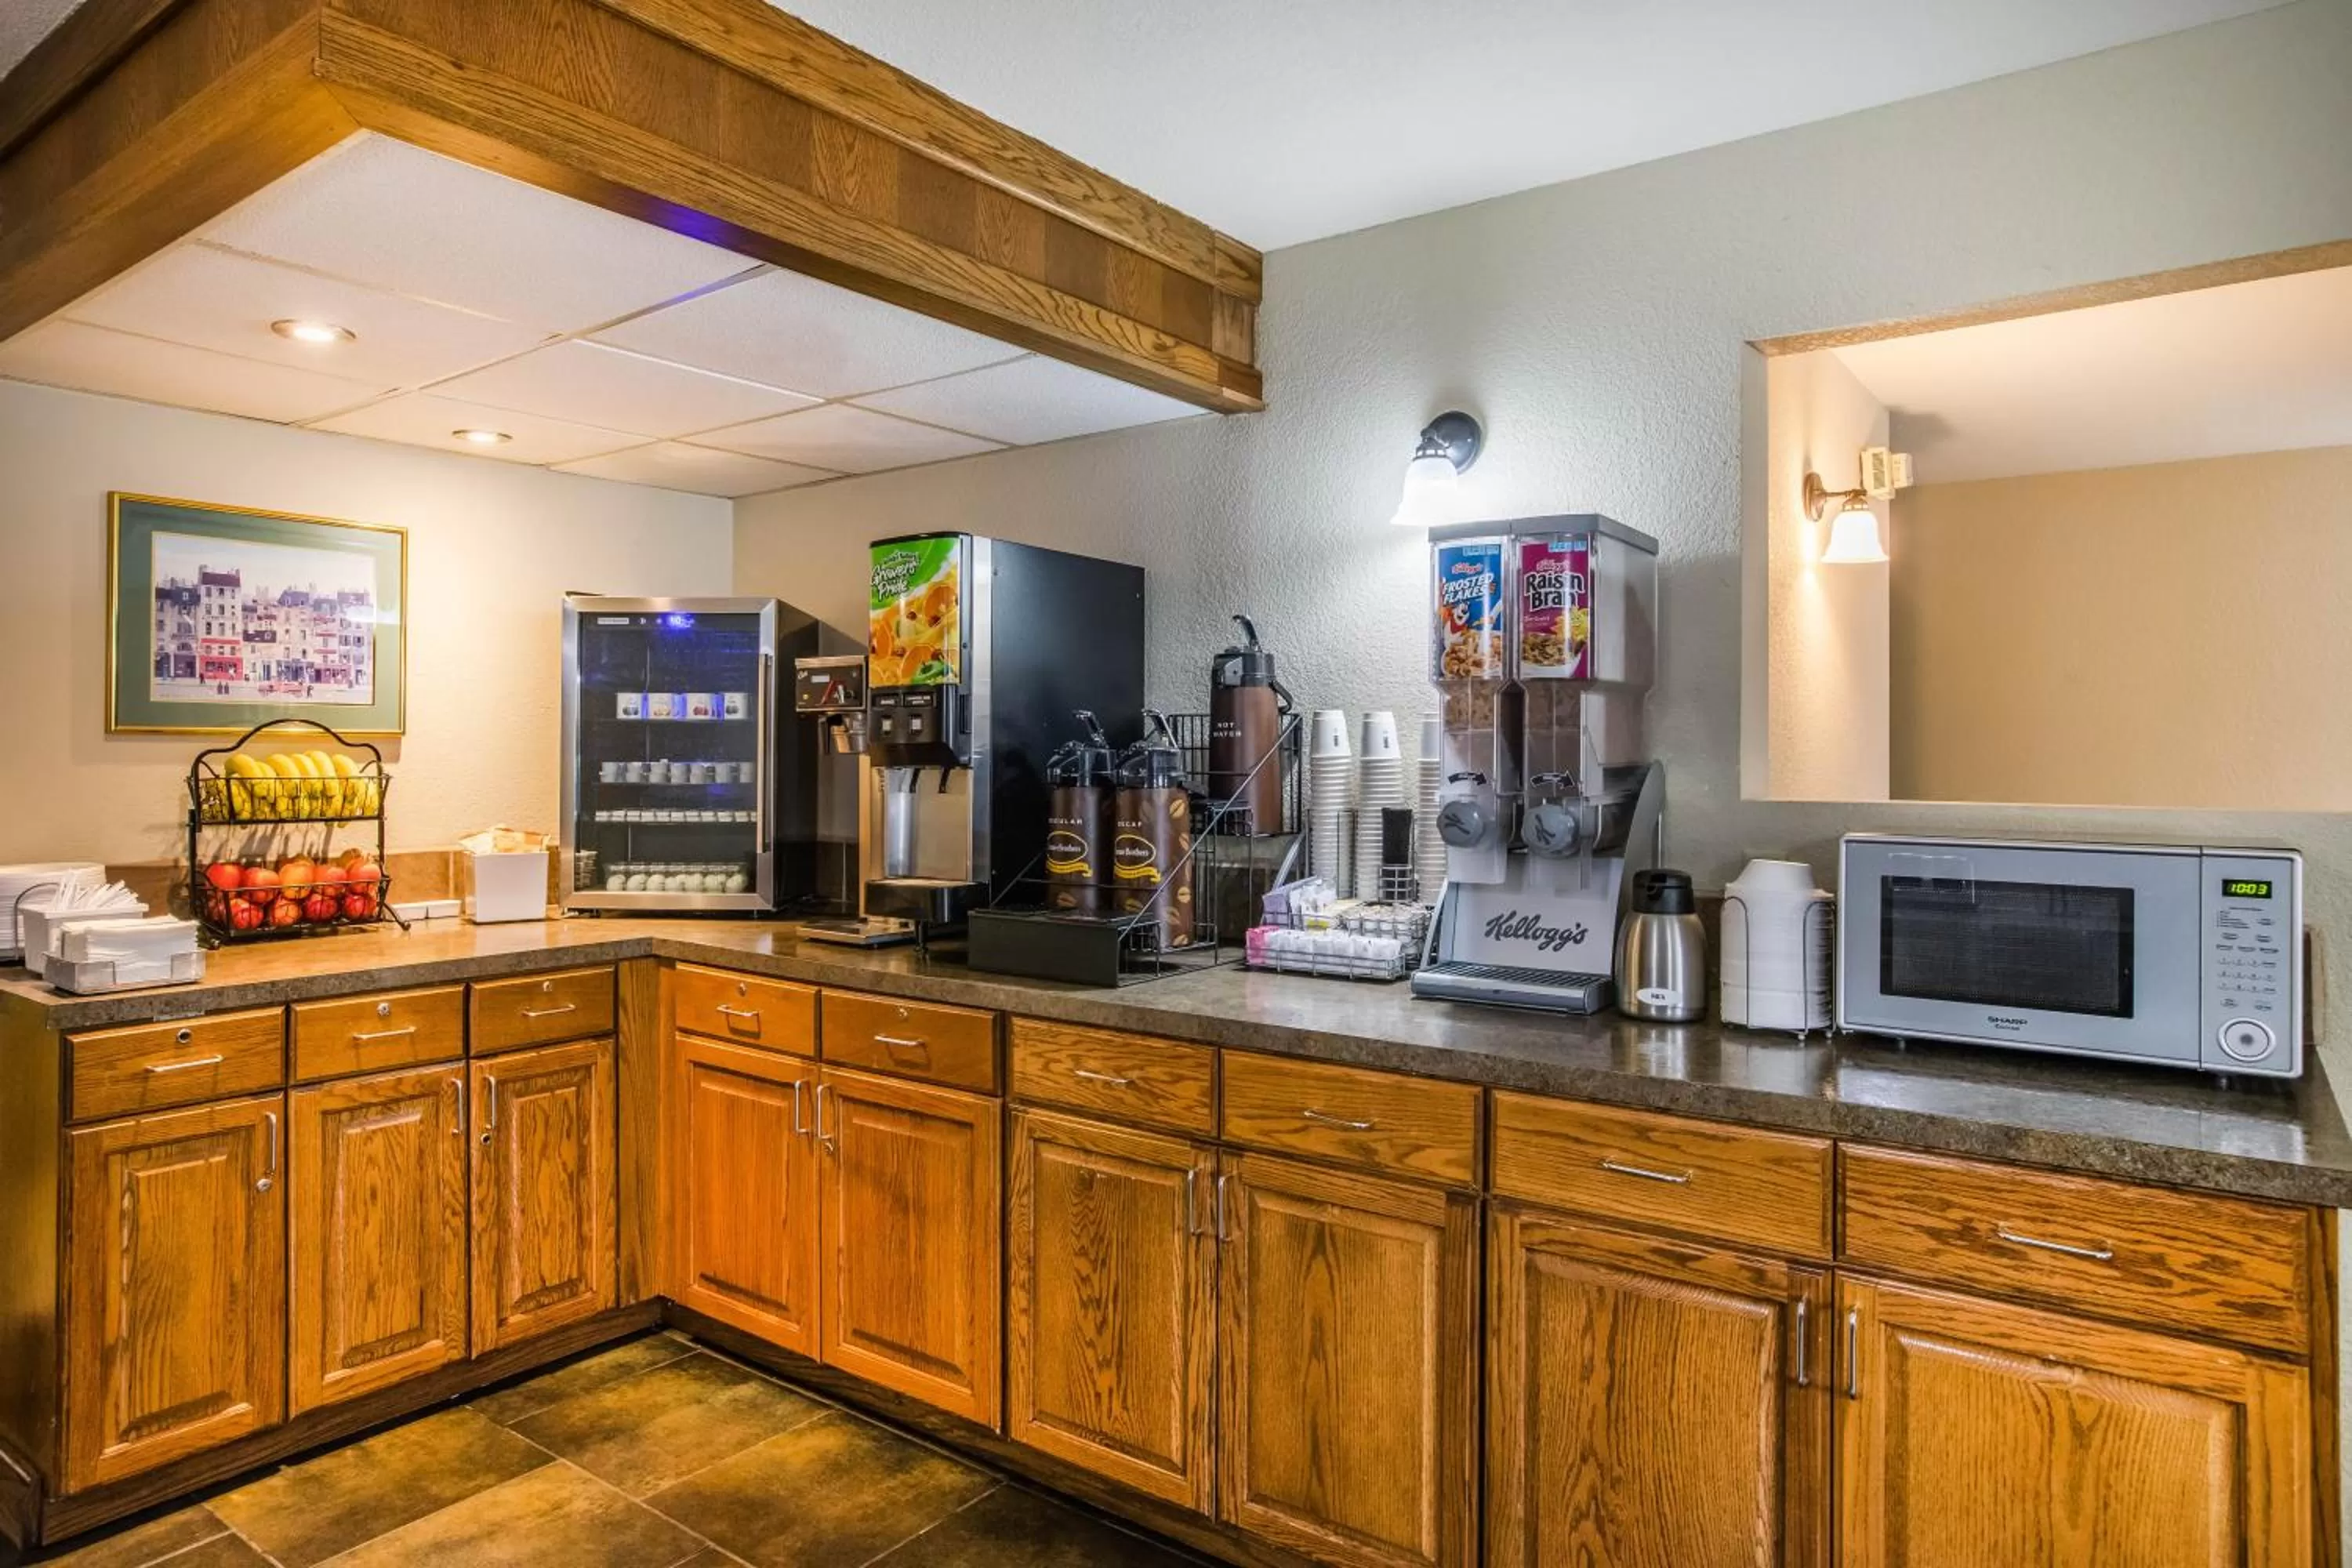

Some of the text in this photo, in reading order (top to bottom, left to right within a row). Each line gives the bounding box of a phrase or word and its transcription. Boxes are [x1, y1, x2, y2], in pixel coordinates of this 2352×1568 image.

[1443, 572, 1494, 595] FROSTED
[1525, 573, 1584, 594] Raisn
[1484, 909, 1589, 953] Kellogg's
[1987, 1015, 2028, 1025] SHARP
